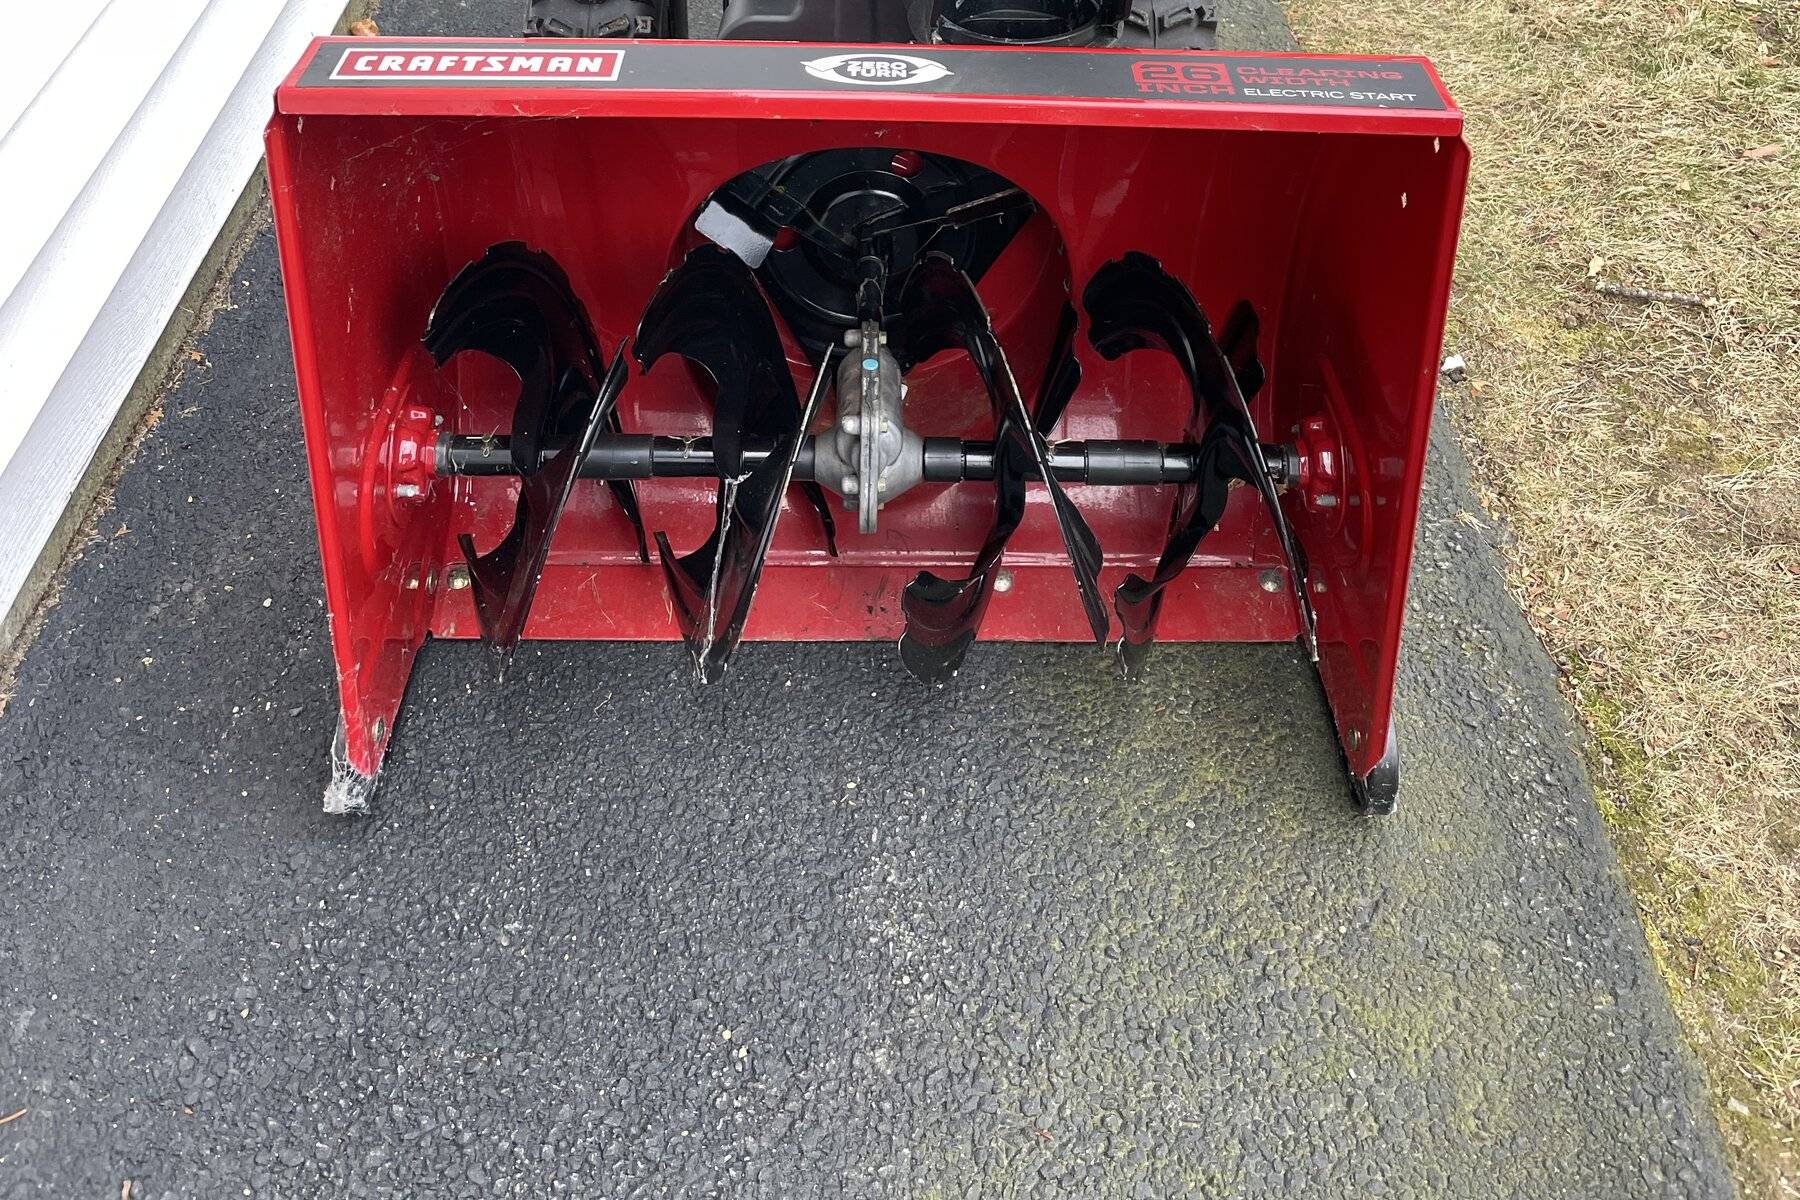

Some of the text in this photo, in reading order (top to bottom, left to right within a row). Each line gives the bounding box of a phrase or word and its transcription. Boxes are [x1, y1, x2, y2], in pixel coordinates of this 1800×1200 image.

[353, 55, 604, 73] CRAFTSMAN
[847, 60, 907, 70] ZERO
[847, 68, 907, 78] TURN
[1139, 63, 1223, 81] 26
[1236, 66, 1403, 80] CLEARING
[1239, 75, 1353, 87] WIDTH
[1136, 83, 1236, 95] INCH
[1243, 88, 1417, 102] ELECTRIC START
